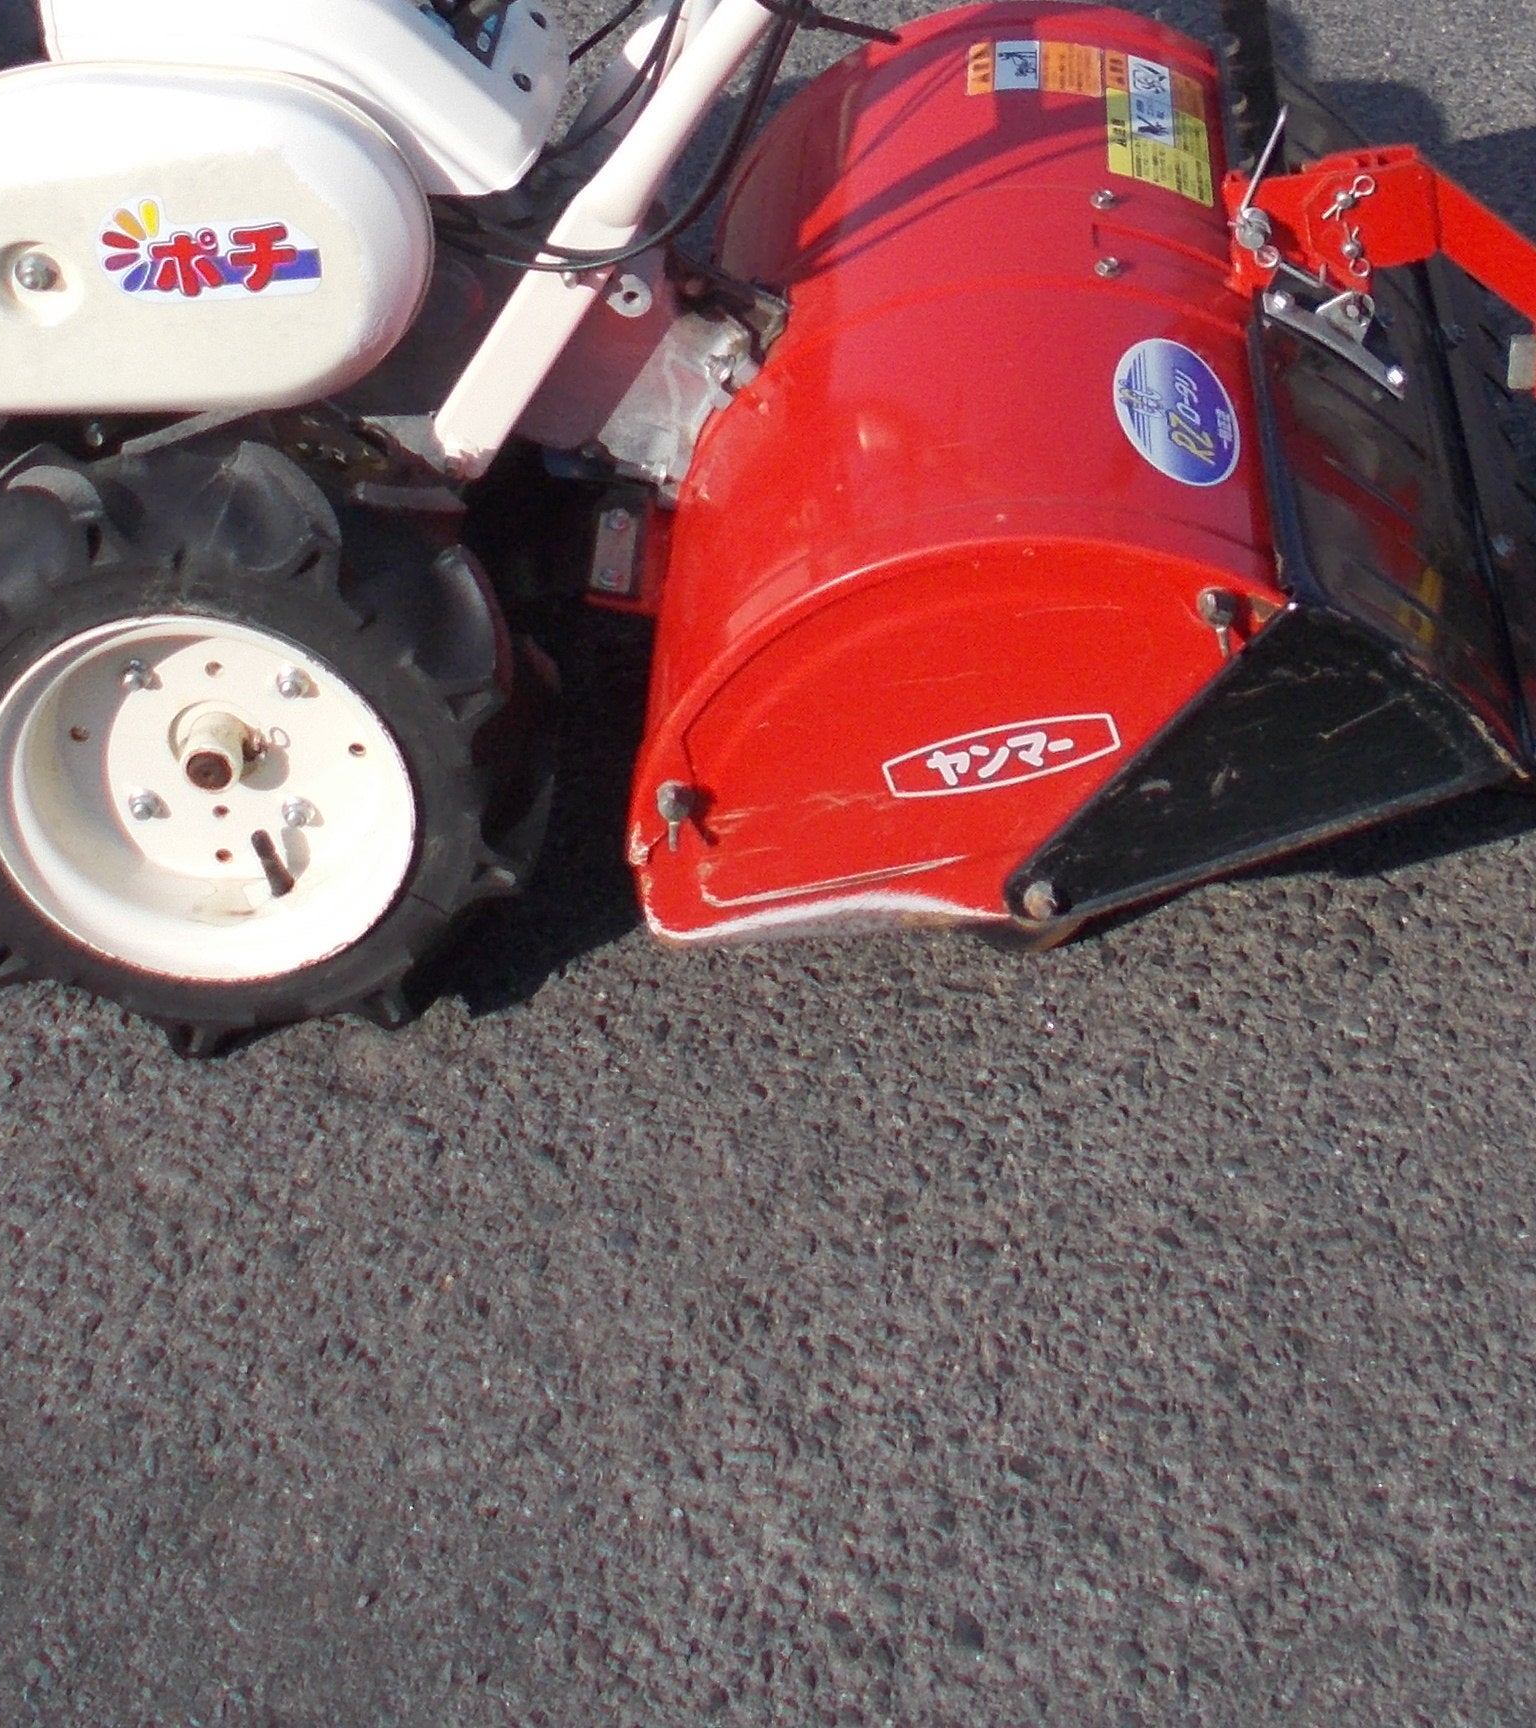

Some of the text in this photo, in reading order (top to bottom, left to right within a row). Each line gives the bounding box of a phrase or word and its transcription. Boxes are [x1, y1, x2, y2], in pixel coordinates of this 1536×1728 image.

[148, 222, 298, 297] ポチ
[925, 731, 1075, 787] ヤンマー
